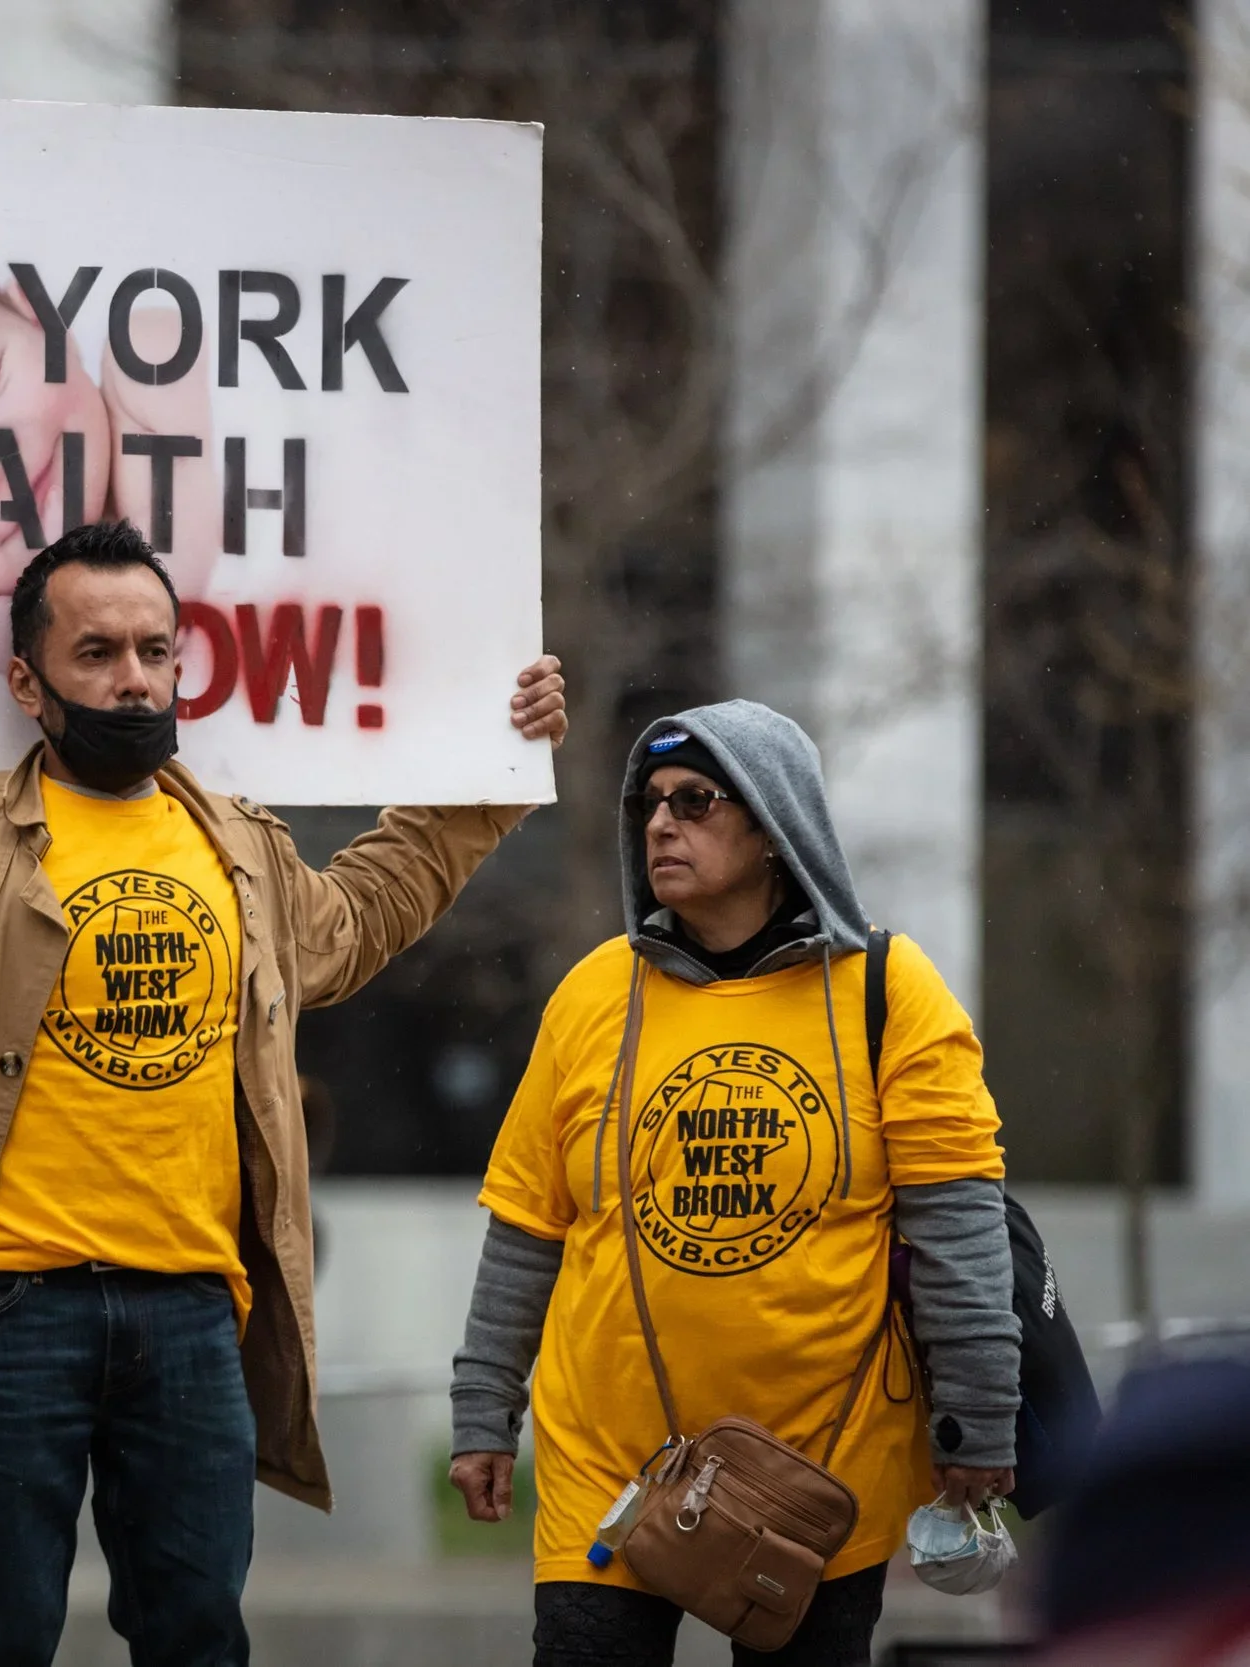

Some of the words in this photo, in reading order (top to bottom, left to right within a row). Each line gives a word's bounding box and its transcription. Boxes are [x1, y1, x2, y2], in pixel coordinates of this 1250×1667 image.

[8, 262, 410, 393] YORK
[177, 601, 384, 728] OW!
[68, 885, 101, 937] AY
[111, 876, 175, 899] YES
[186, 894, 215, 935] TO
[144, 910, 168, 925] THE
[95, 932, 200, 965] NORTH-
[104, 969, 180, 1000] WEST
[95, 1004, 189, 1038] BRONX
[643, 1061, 694, 1132] SAY
[706, 1050, 782, 1075] YES
[787, 1071, 821, 1115] TO
[735, 1086, 764, 1100] THE
[677, 1107, 796, 1142] NORTH-
[683, 1144, 769, 1177] WEST
[672, 1183, 777, 1218] BRONX
[635, 1191, 814, 1267] N.W.B.C.C.C.
